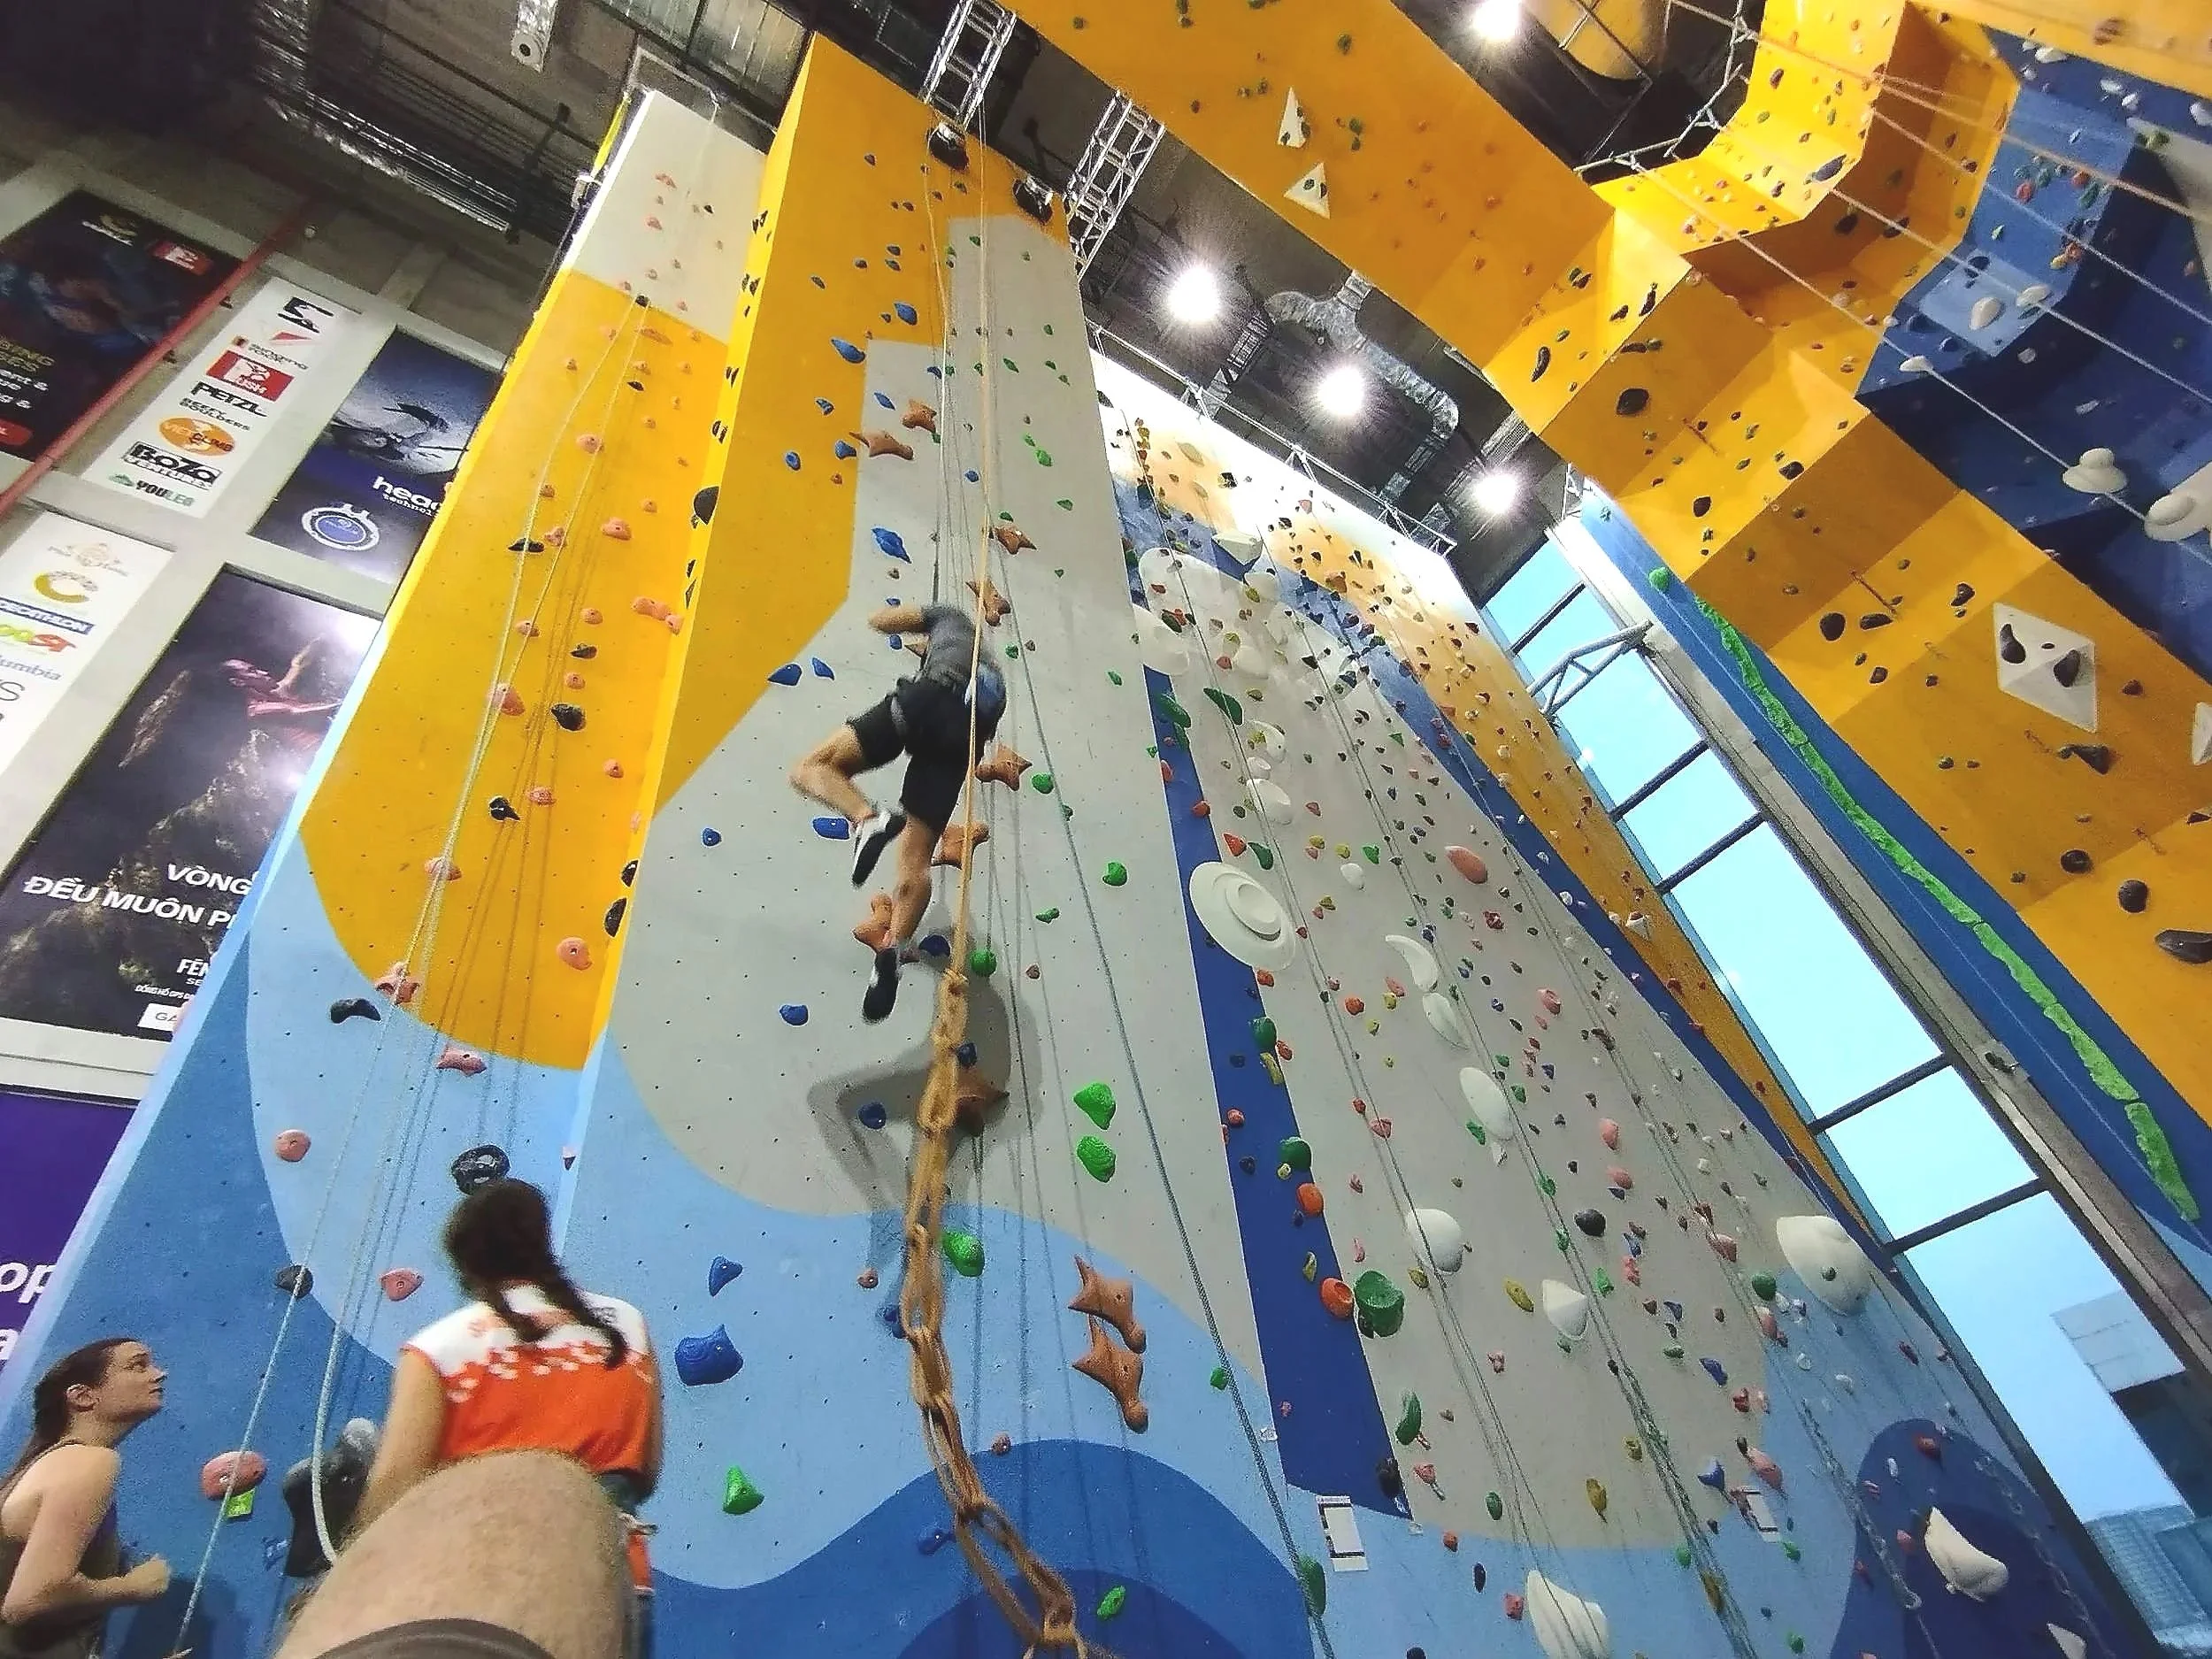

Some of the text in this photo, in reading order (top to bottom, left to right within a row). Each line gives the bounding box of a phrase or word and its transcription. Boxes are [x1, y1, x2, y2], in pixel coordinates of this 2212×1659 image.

[191, 381, 267, 417] PETZL
[166, 863, 252, 895] VÒNG
[22, 875, 100, 902] ĐỀU
[102, 889, 205, 924] MUÔN
